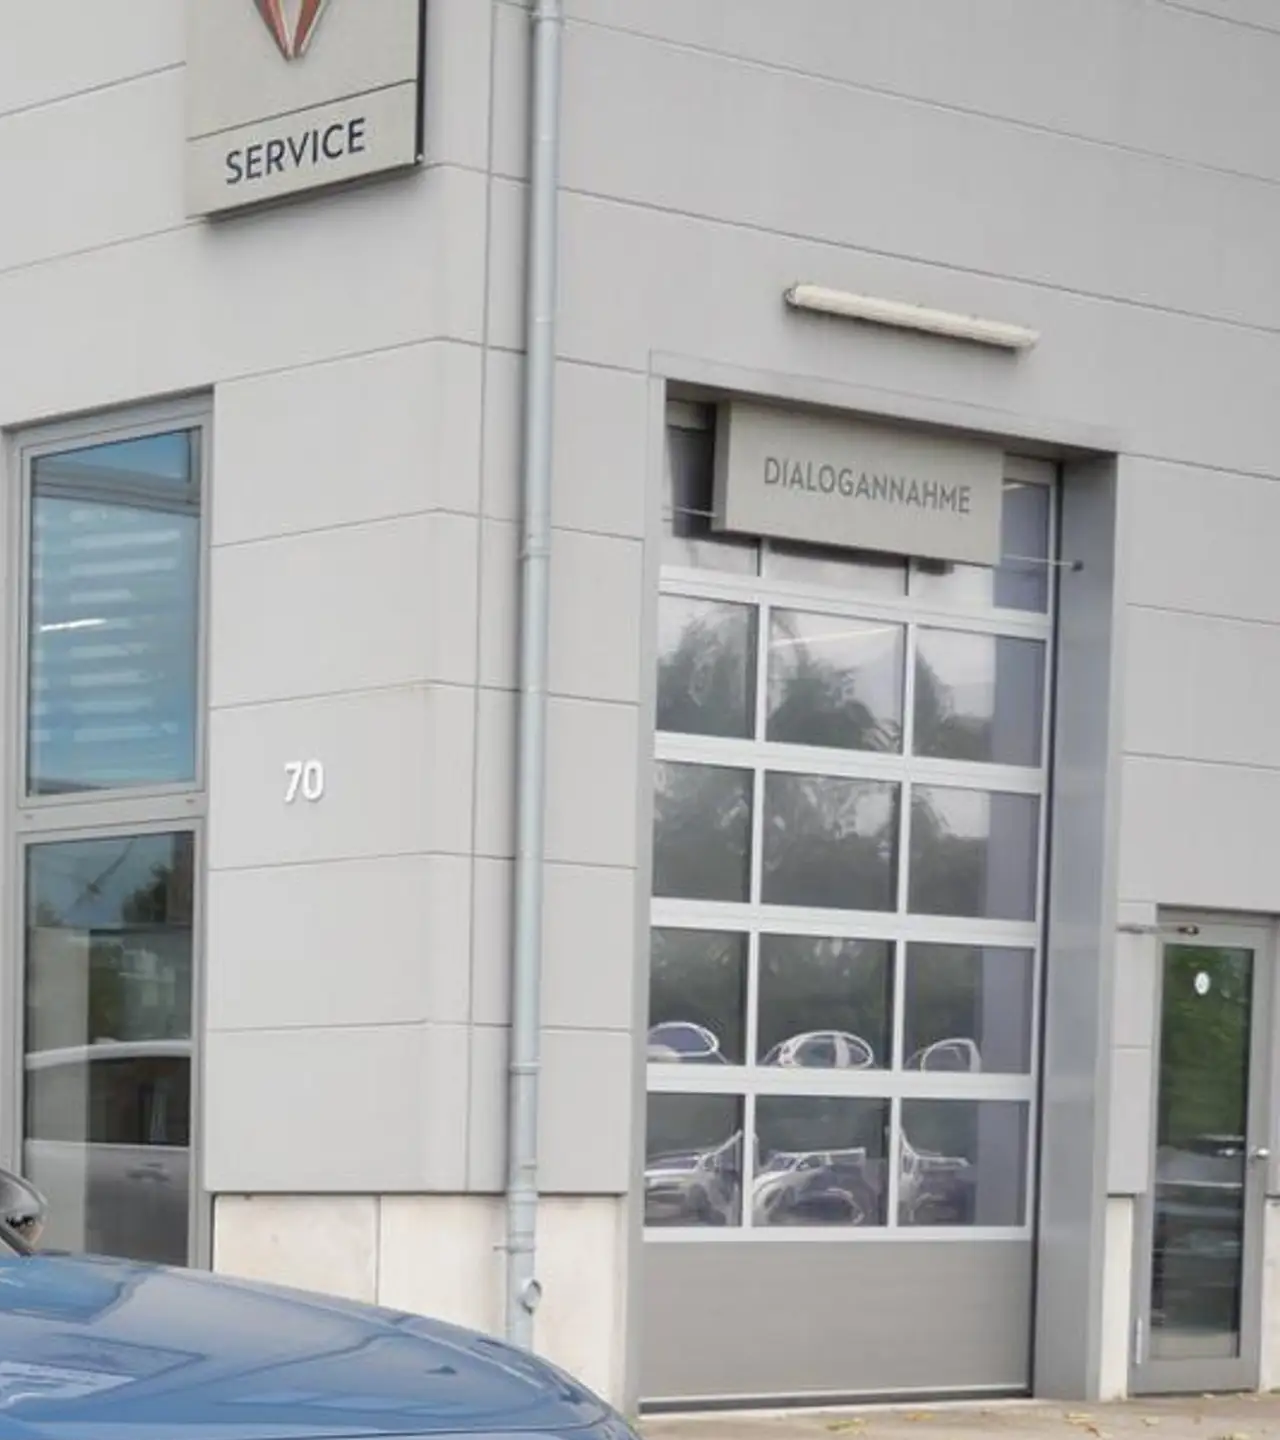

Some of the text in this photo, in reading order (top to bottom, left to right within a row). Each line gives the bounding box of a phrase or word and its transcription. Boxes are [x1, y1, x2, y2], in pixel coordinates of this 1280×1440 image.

[225, 117, 366, 185] SERVICE
[764, 456, 973, 514] DIALOGANNAHME
[285, 760, 324, 802] 70
